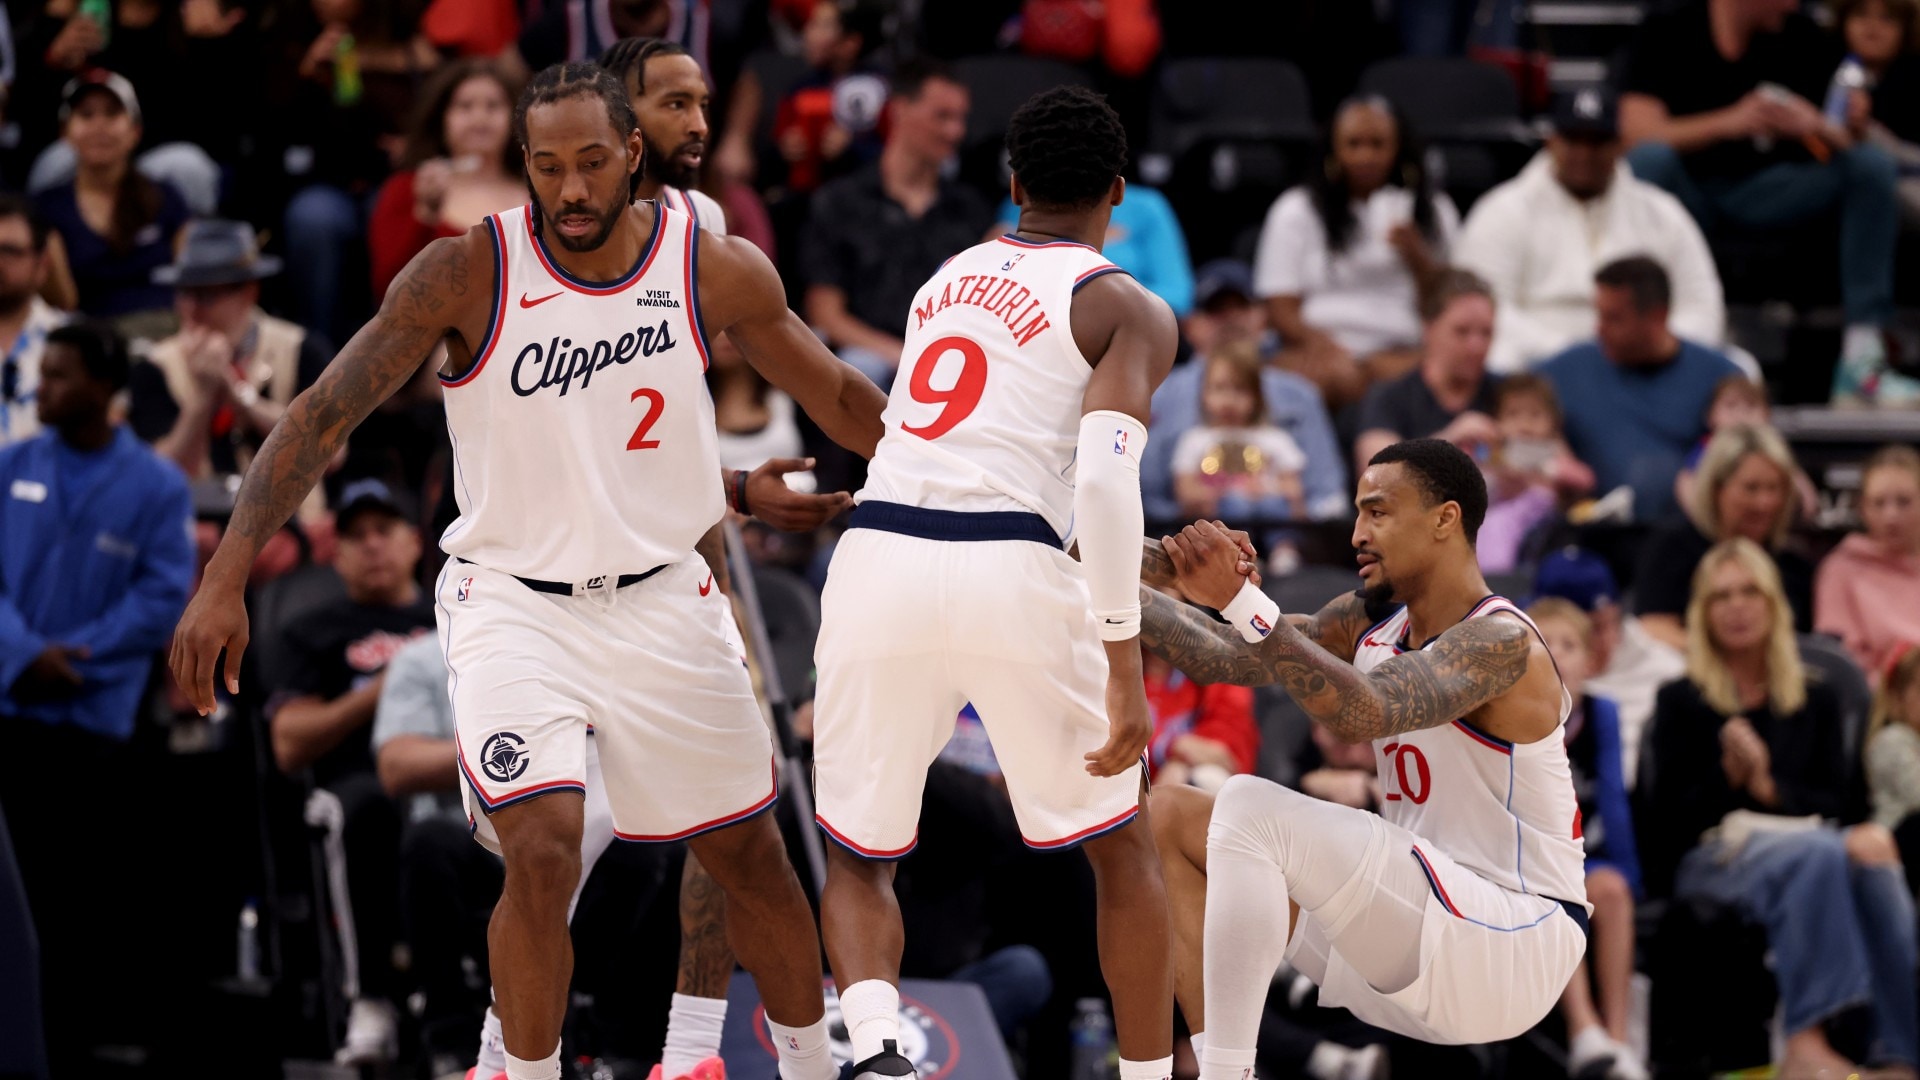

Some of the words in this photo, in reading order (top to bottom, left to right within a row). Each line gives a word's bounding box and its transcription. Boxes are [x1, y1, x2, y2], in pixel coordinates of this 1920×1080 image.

[636, 298, 681, 308] RWANDA
[645, 289, 671, 299] VISIT
[914, 274, 1050, 347] MATHURIN
[510, 319, 677, 397] Clippers
[901, 335, 988, 441] 9
[626, 387, 665, 451] 2
